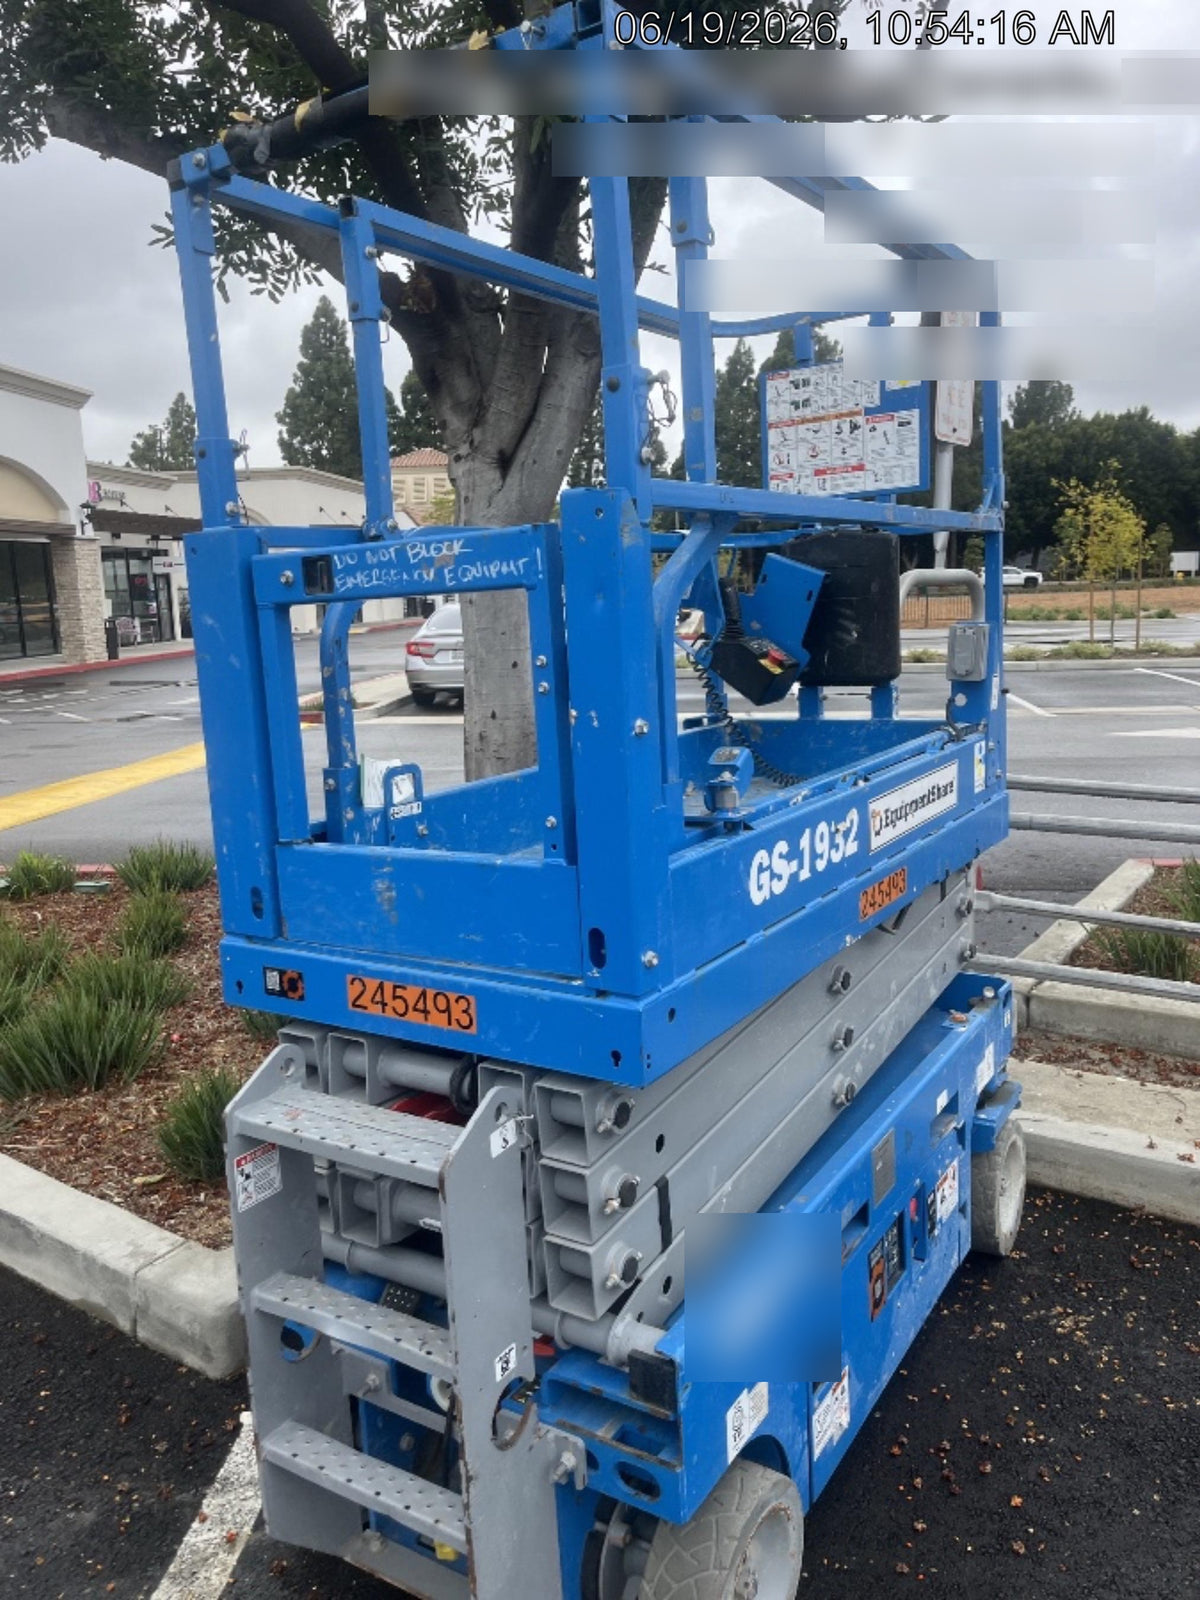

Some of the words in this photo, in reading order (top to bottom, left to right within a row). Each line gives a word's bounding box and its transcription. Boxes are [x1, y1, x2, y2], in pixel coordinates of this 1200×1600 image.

[333, 552, 359, 570] DO
[365, 545, 401, 565] NOT
[406, 539, 474, 564] BLOCK
[749, 807, 860, 906] GS-1932
[860, 867, 907, 920] 245493
[348, 976, 476, 1031] 245493
